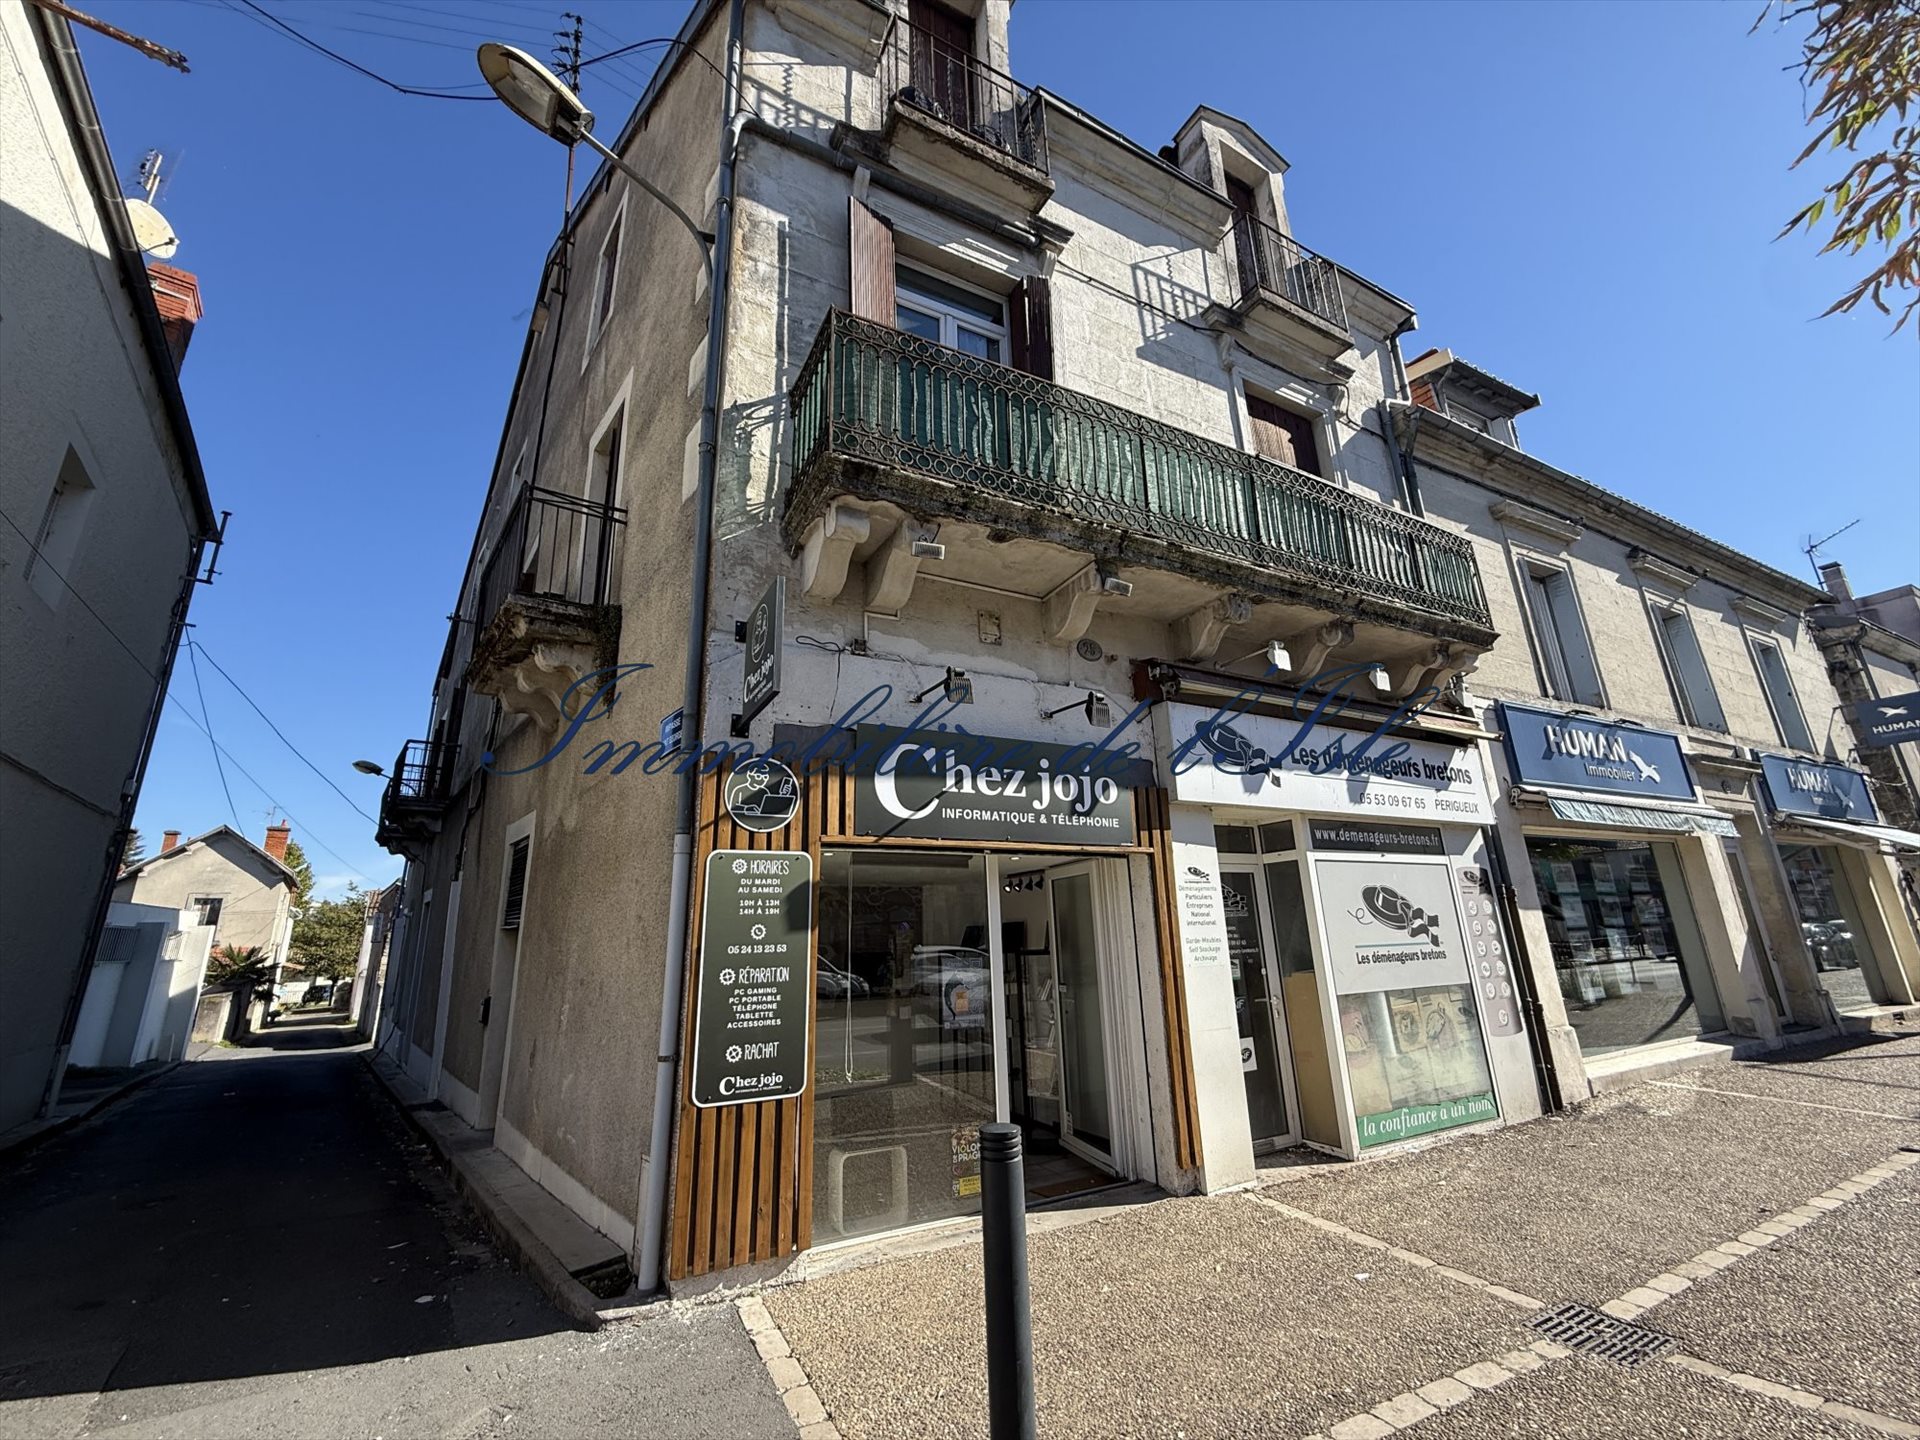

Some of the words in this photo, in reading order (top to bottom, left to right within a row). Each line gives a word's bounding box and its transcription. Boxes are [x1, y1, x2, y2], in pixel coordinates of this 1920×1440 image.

[744, 668, 761, 703] Chez
[760, 653, 774, 681] jojo
[1545, 725, 1628, 763] HUMAN
[1290, 741, 1320, 767] Les
[1422, 758, 1473, 785] bretons
[1585, 762, 1636, 782] Immobilier
[874, 743, 1027, 820] Chez
[1032, 758, 1118, 812] jojo
[1360, 792, 1372, 805] 05
[1374, 794, 1386, 806] 53
[1387, 795, 1400, 807] 09
[1401, 796, 1413, 809] 67
[1414, 798, 1426, 810] 65
[942, 807, 1036, 824] INFORMATIQUE
[1039, 814, 1048, 824] &
[1051, 812, 1120, 828] TÉLÉPHONIE
[1314, 827, 1439, 847] www.demenageurs-bretons.fr
[750, 860, 790, 875] HORAIRES
[728, 946, 740, 954] 05
[741, 945, 752, 953] 24
[753, 945, 763, 953] 13
[764, 944, 775, 953] 23
[776, 944, 787, 953] 53
[1356, 951, 1371, 965] Les
[1371, 949, 1420, 965] déménageurs
[1420, 948, 1447, 961] bretons
[739, 966, 790, 984] RÉPARATION
[732, 1003, 778, 1012] TÉLÉPHONE
[742, 995, 781, 1003] PORTABLE
[727, 1019, 781, 1029] ACCESSOIRES
[735, 1011, 774, 1020] TABLETTE
[744, 1041, 780, 1060] RACHAT
[719, 1076, 758, 1095] Chez
[758, 1072, 783, 1087] jojo
[1363, 1116, 1377, 1137] la
[1380, 1108, 1437, 1137] confiance
[1451, 1104, 1466, 1118] un
[1467, 1099, 1492, 1114] nom
